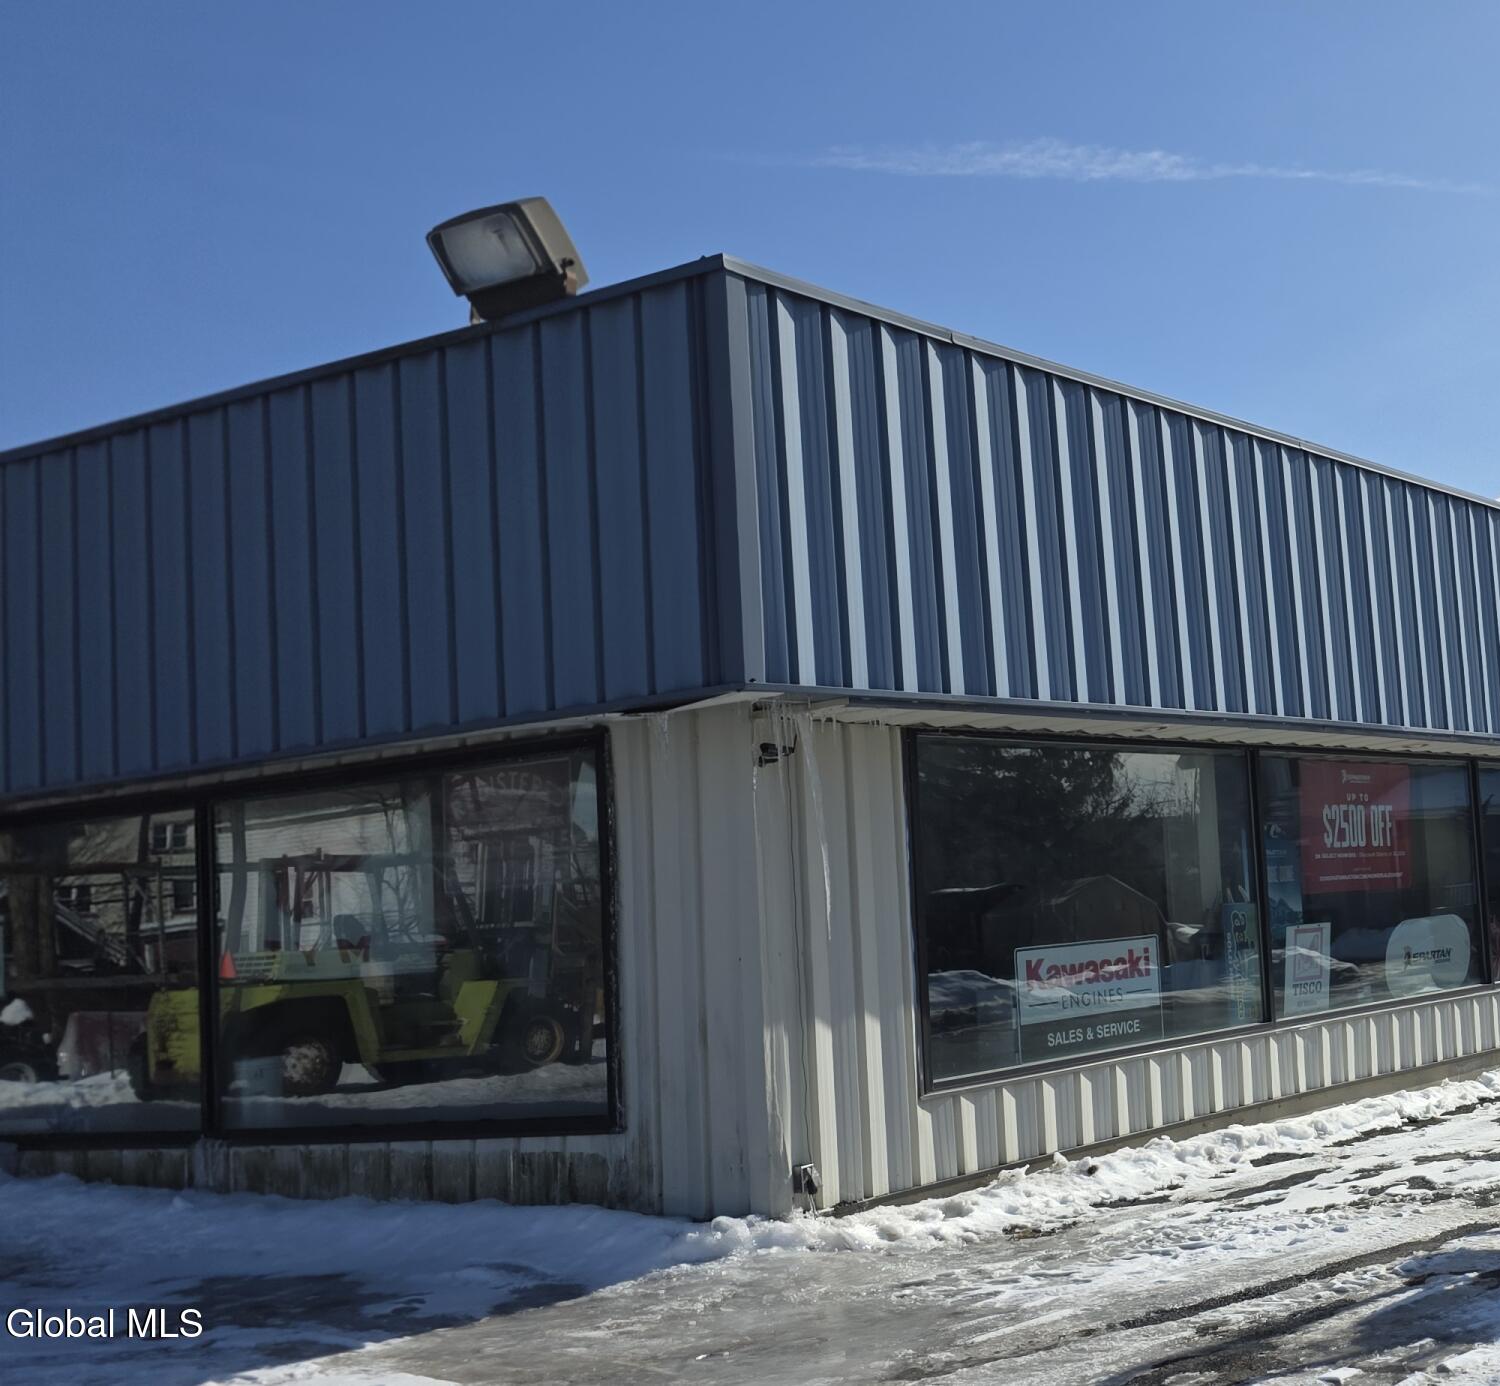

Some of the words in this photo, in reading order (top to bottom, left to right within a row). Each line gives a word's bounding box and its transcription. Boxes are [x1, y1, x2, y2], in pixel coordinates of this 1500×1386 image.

[1346, 792, 1356, 802] UP
[1360, 792, 1369, 802] TO
[1322, 803, 1367, 848] $2500
[1370, 804, 1393, 847] OFF
[1025, 947, 1151, 991] Kawasaki
[1061, 987, 1123, 1010] ENGINES
[1292, 980, 1323, 997] TISCO
[1047, 1028, 1084, 1047] SALES
[1086, 1027, 1095, 1041] &
[1096, 1019, 1141, 1039] SERVICE
